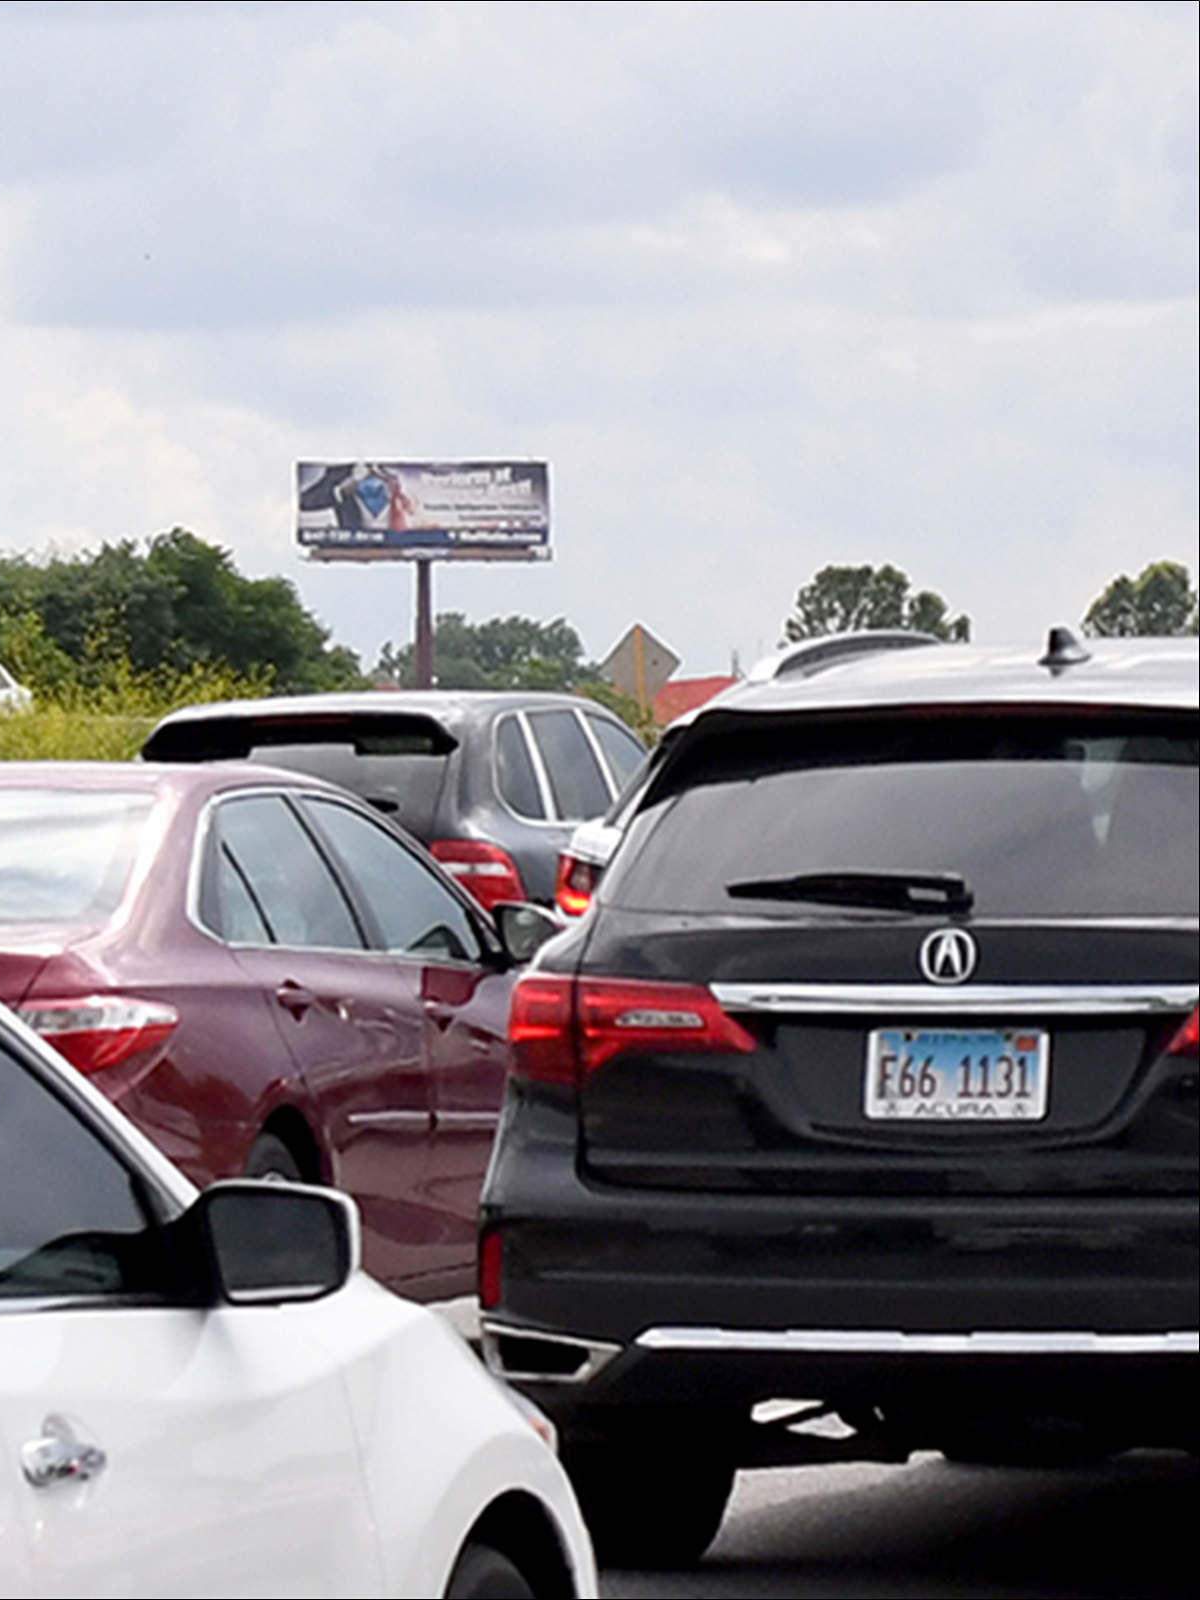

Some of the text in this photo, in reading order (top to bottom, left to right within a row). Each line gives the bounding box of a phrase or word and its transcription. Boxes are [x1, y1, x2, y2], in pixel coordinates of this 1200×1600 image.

[878, 1055, 1031, 1099] F66 1131
[914, 1102, 998, 1116] ACURA
